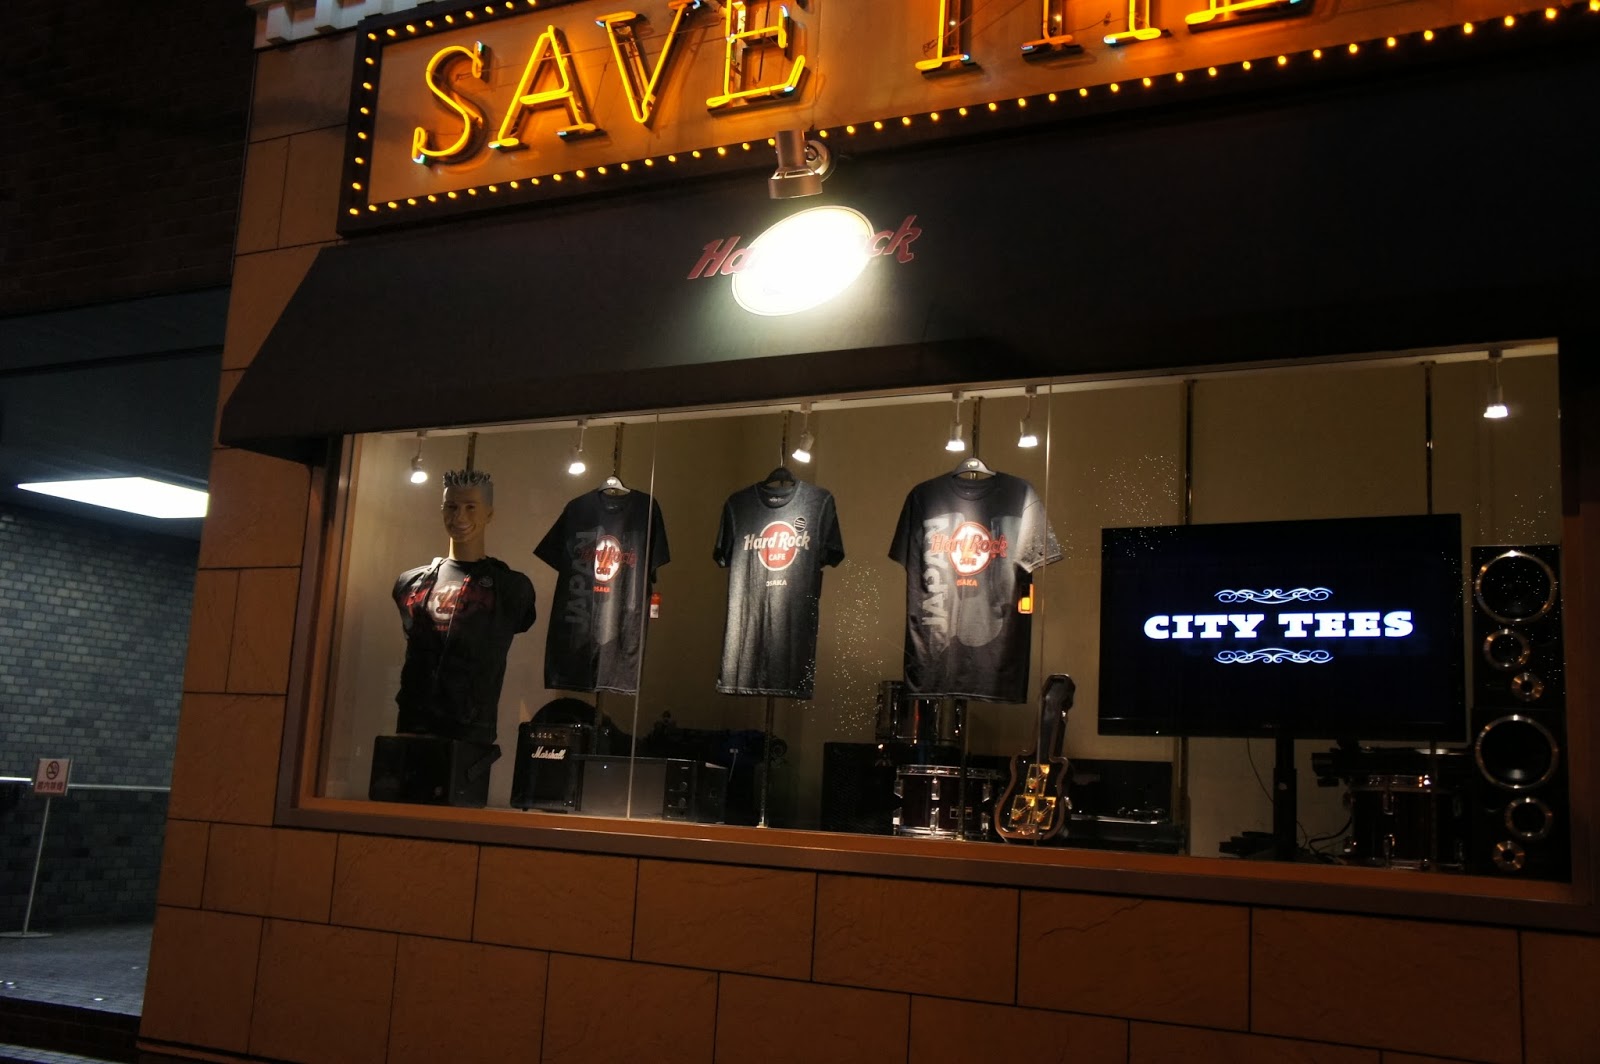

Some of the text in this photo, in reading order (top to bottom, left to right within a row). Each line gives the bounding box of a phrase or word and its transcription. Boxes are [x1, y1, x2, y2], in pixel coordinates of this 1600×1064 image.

[411, 0, 806, 165] SAVE
[743, 530, 811, 551] Hard Rock
[930, 532, 1008, 558] Hard Rock
[768, 553, 786, 561] CAFE
[766, 579, 788, 587] OSAKA
[921, 517, 950, 636] JAPAN
[1143, 610, 1414, 640] CITY TEES
[531, 745, 567, 760] Marshall
